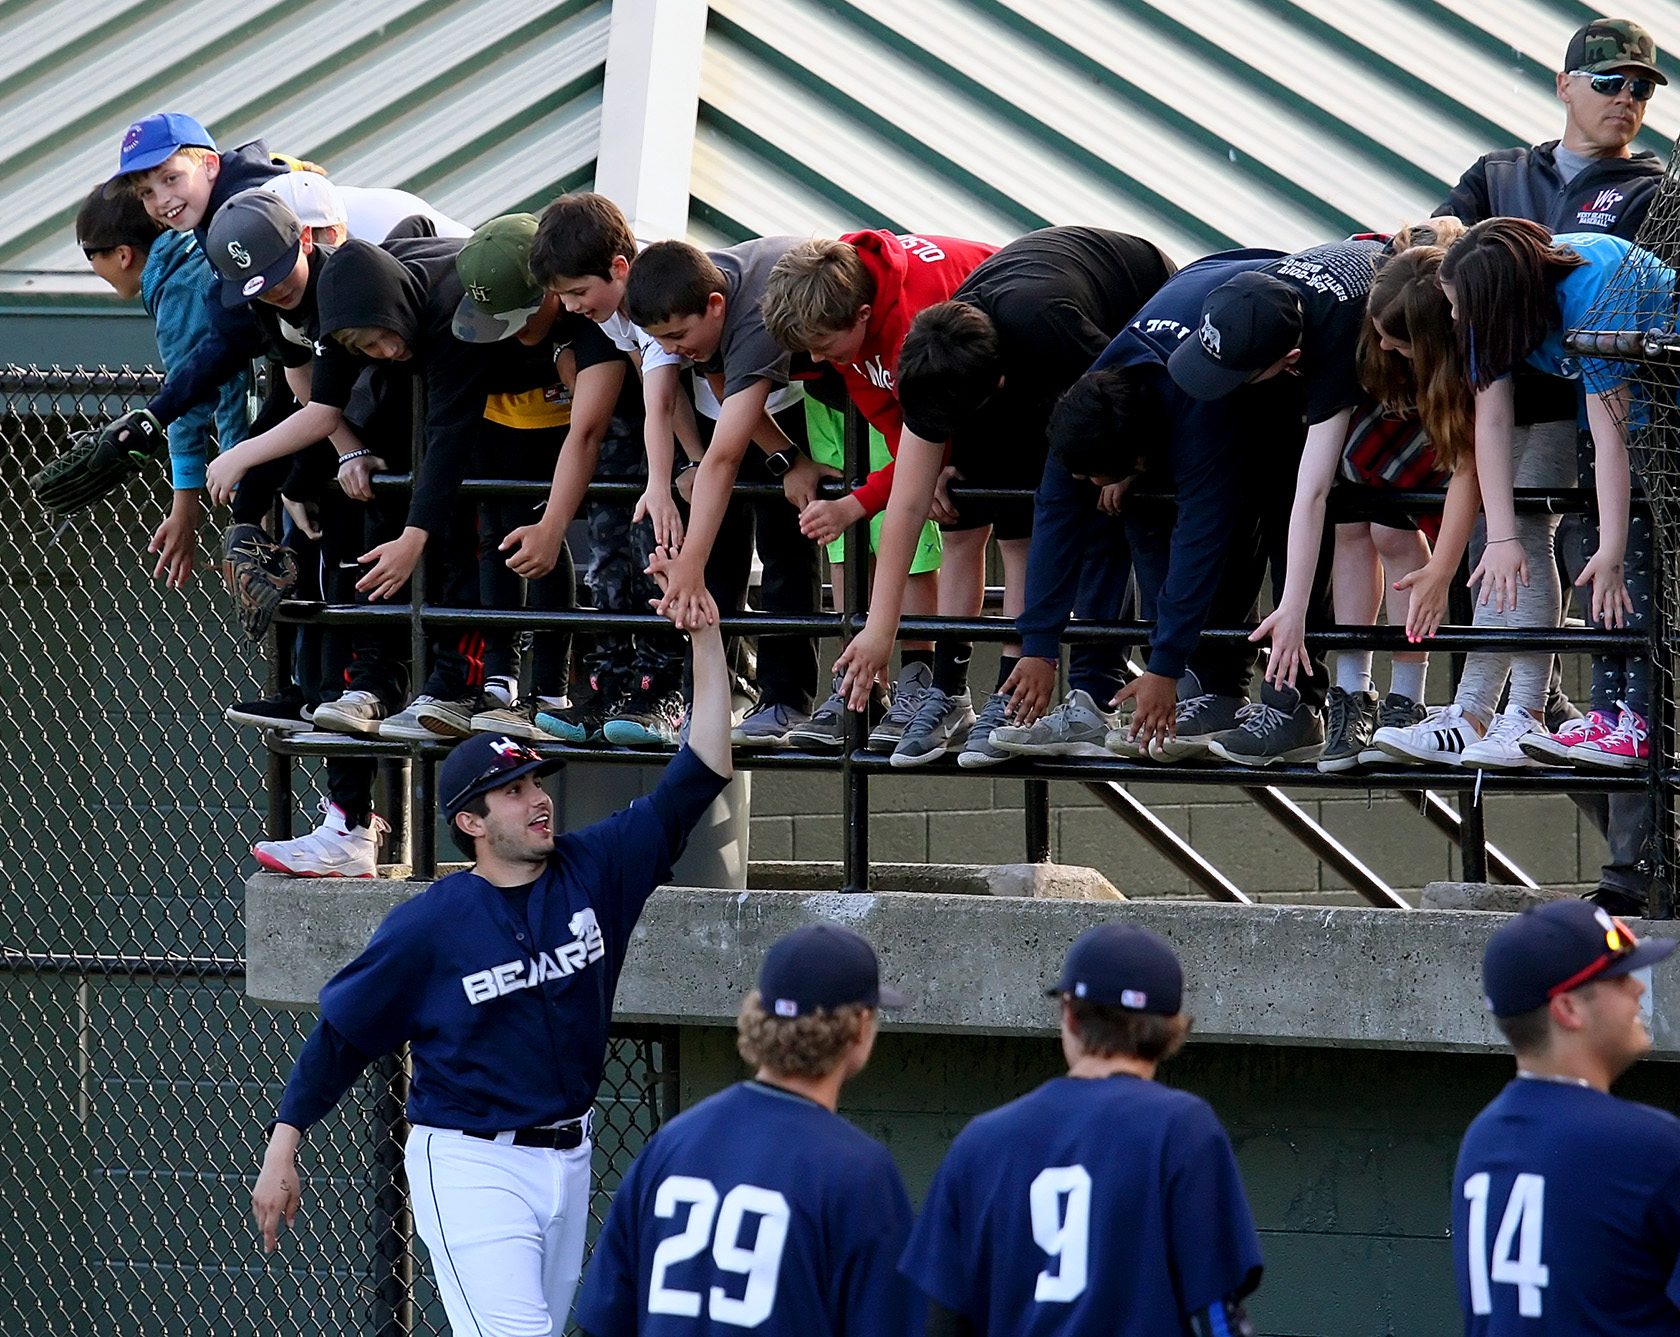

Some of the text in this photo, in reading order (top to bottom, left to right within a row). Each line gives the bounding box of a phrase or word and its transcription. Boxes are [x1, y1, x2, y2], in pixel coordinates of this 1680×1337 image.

[1577, 211, 1616, 223] WEST SEATTLE
[1578, 217, 1608, 227] BASEBALL
[1321, 273, 1348, 302] SEATTLE
[461, 926, 605, 1006] BEARS
[647, 1176, 791, 1328] 29
[1029, 1164, 1092, 1303] 9
[1463, 1171, 1550, 1317] 14
